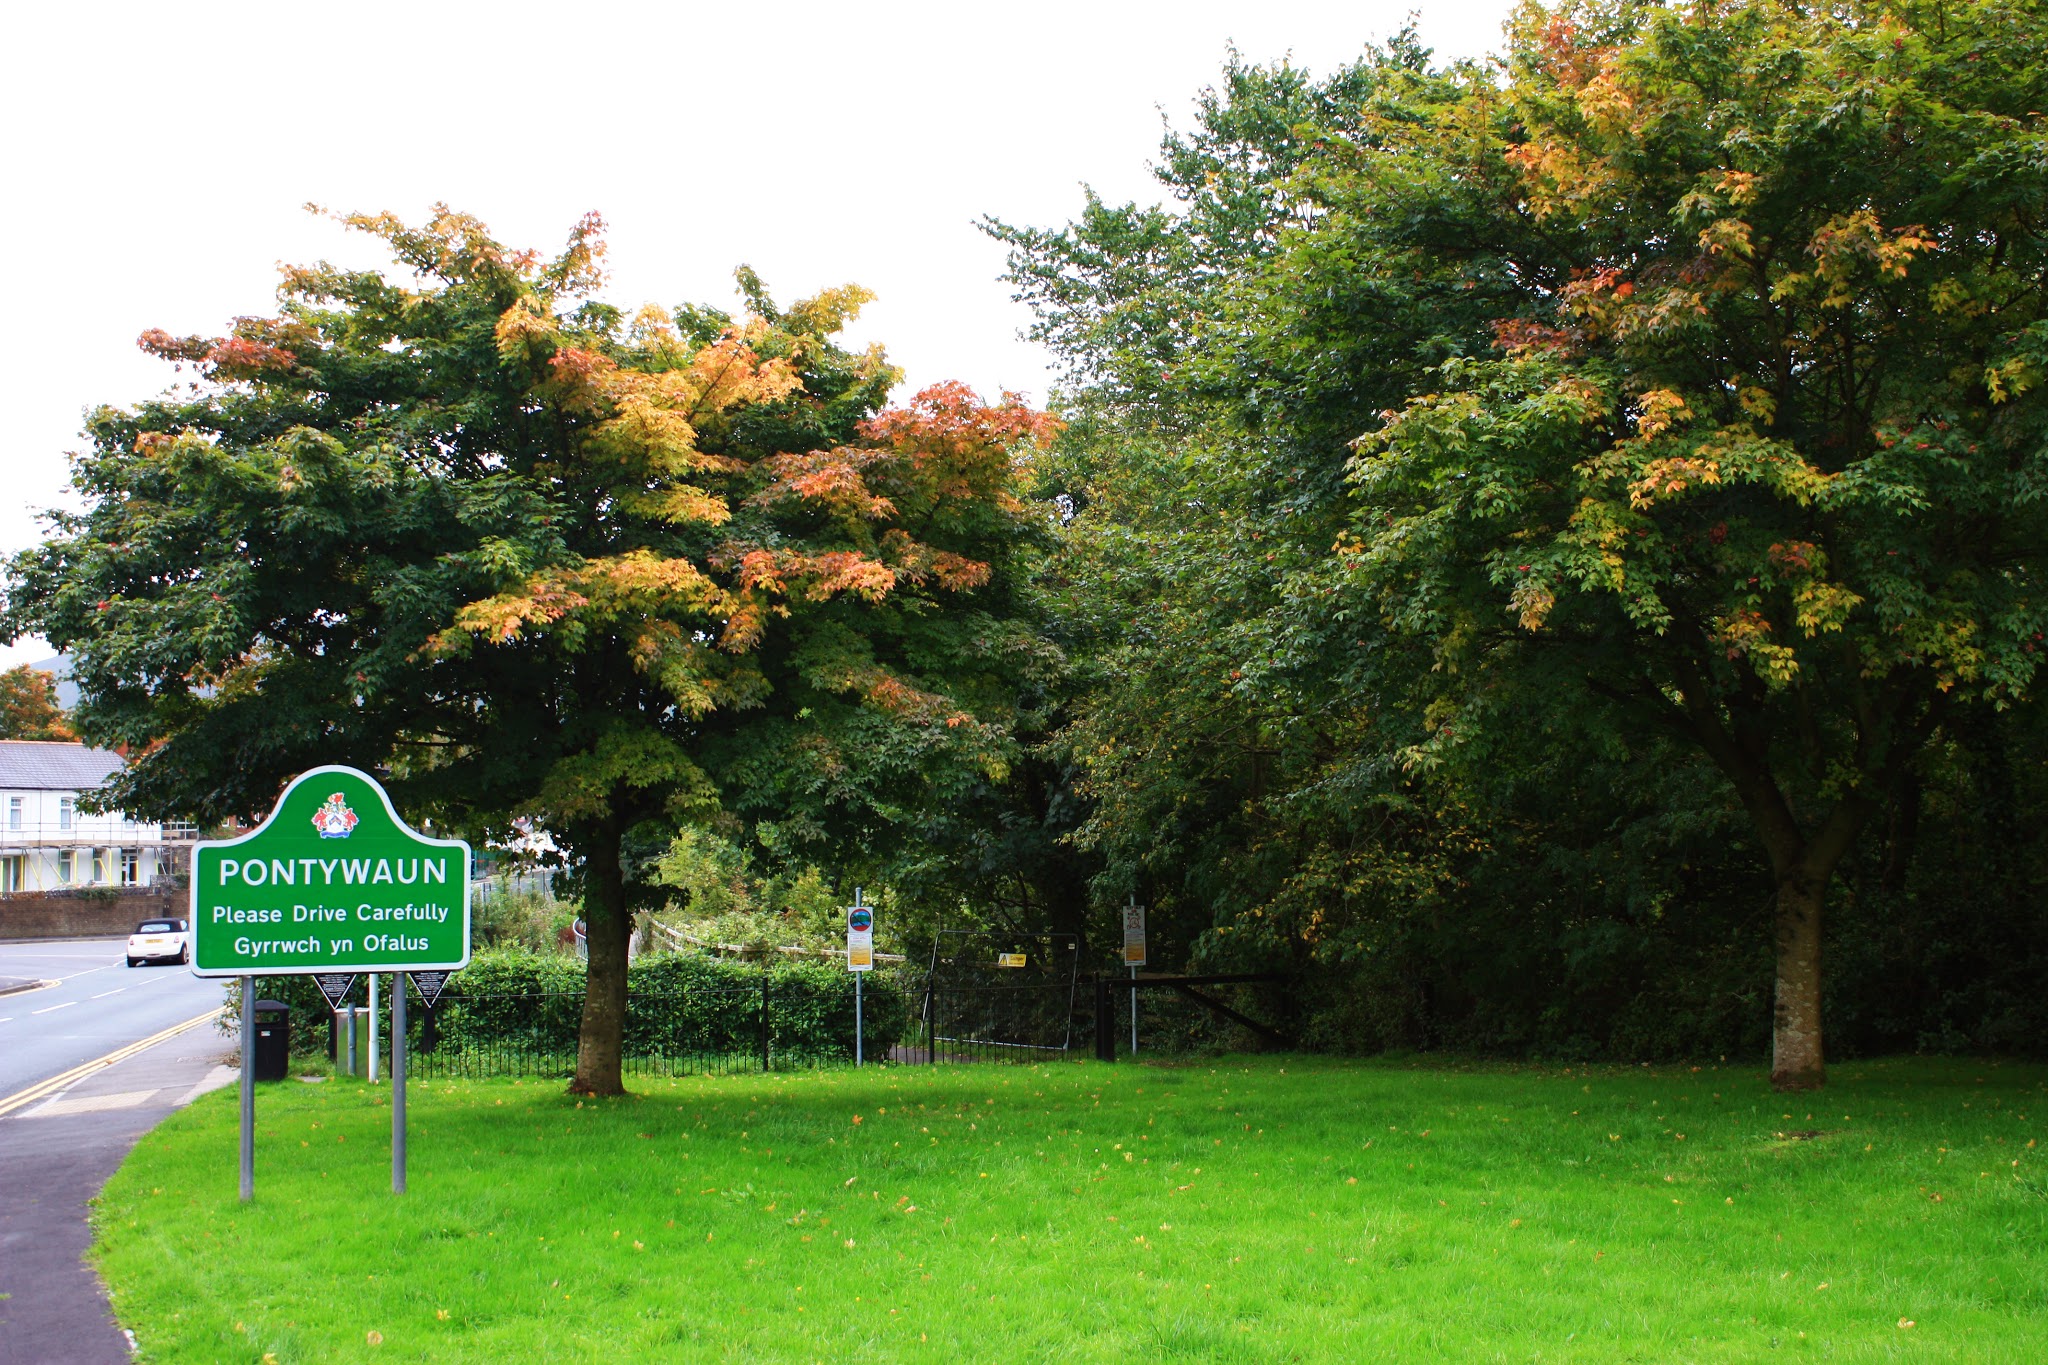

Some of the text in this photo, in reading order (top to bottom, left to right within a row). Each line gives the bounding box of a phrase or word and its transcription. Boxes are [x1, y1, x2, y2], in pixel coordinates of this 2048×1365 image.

[220, 859, 446, 885] PONTYWAUN
[213, 903, 449, 923] Please Drive Carefully
[234, 935, 429, 957] Gyrrwch yn Ofalus
